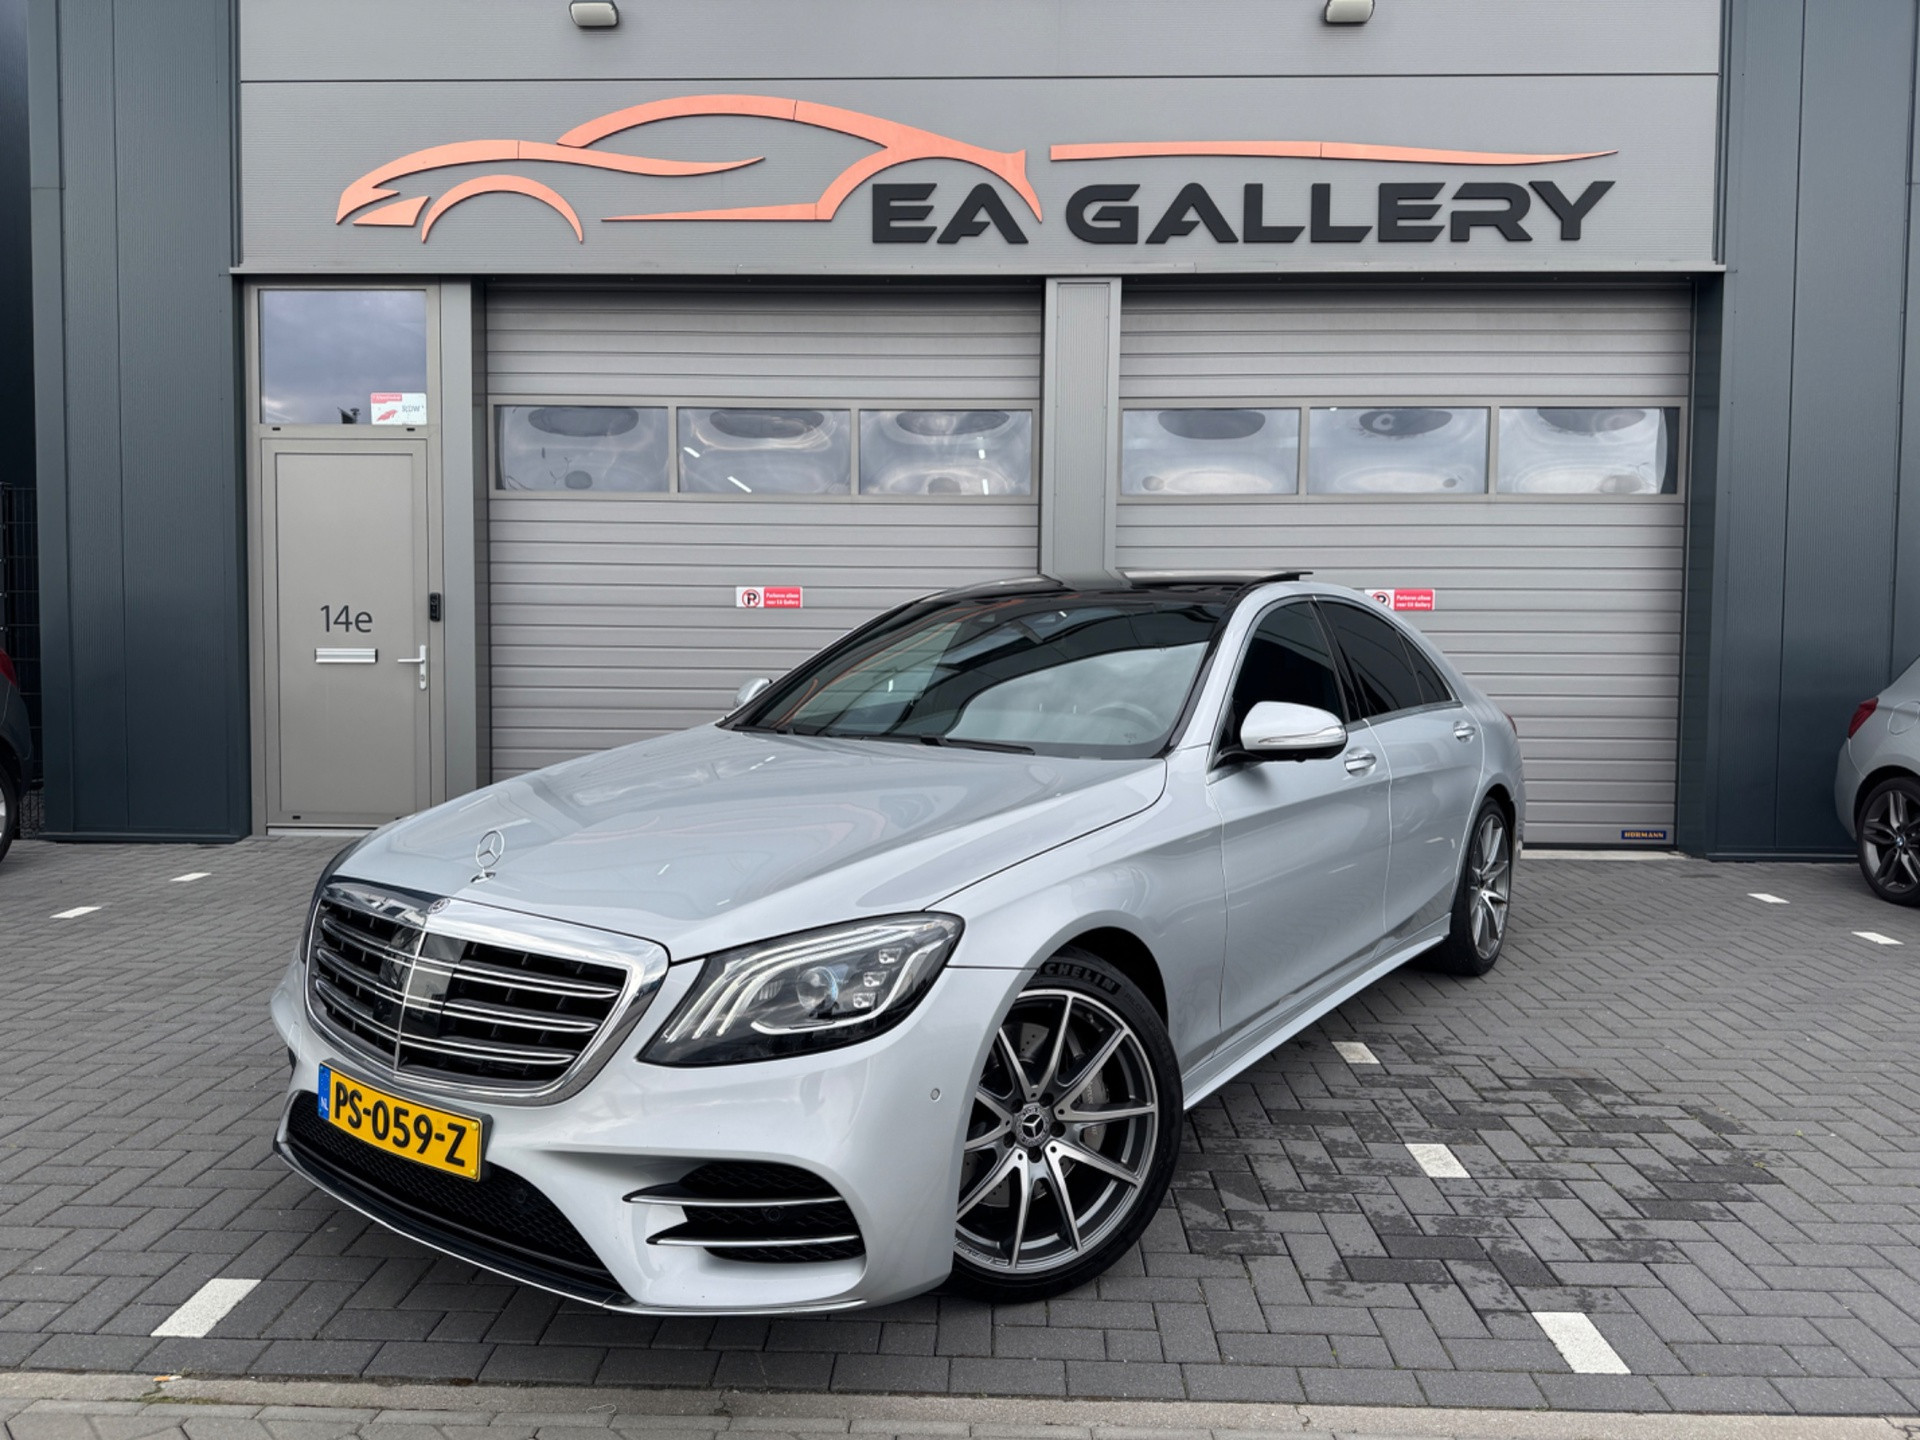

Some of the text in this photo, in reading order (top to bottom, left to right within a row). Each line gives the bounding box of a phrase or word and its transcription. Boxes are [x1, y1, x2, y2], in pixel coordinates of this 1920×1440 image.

[872, 180, 1617, 245] EA GALLERY
[320, 604, 373, 633] 14e
[334, 1081, 467, 1167] PS-059-Z
